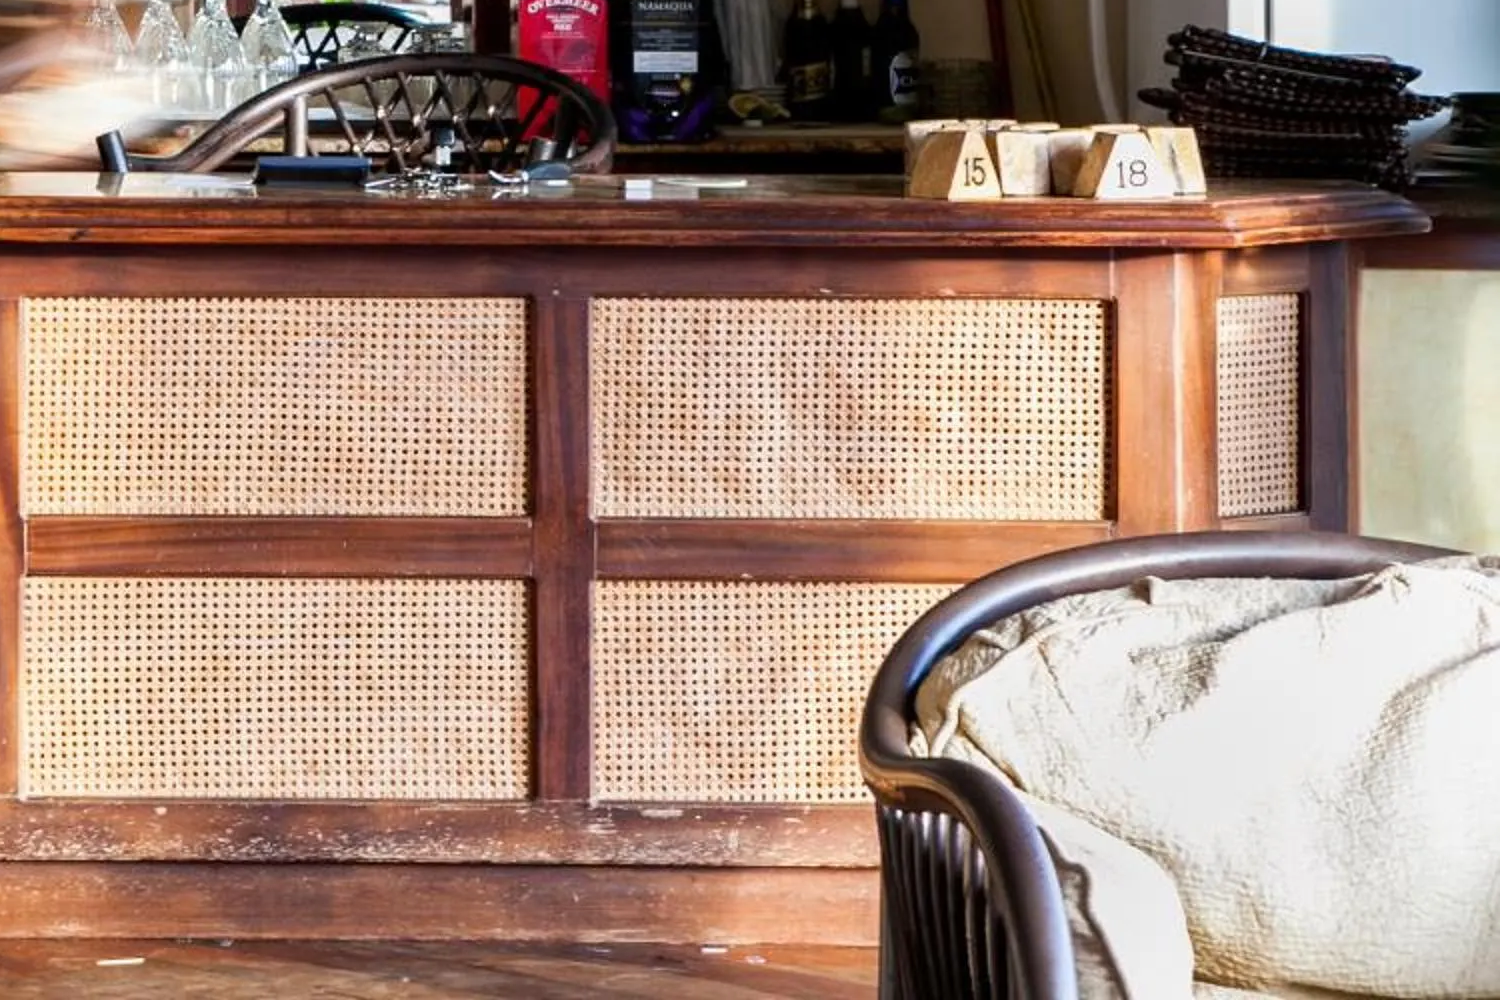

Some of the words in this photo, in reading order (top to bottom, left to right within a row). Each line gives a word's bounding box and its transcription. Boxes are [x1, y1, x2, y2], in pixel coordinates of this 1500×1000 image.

[638, 1, 694, 11] NAMAQUA
[963, 157, 987, 187] 15
[1115, 160, 1148, 188] 18
